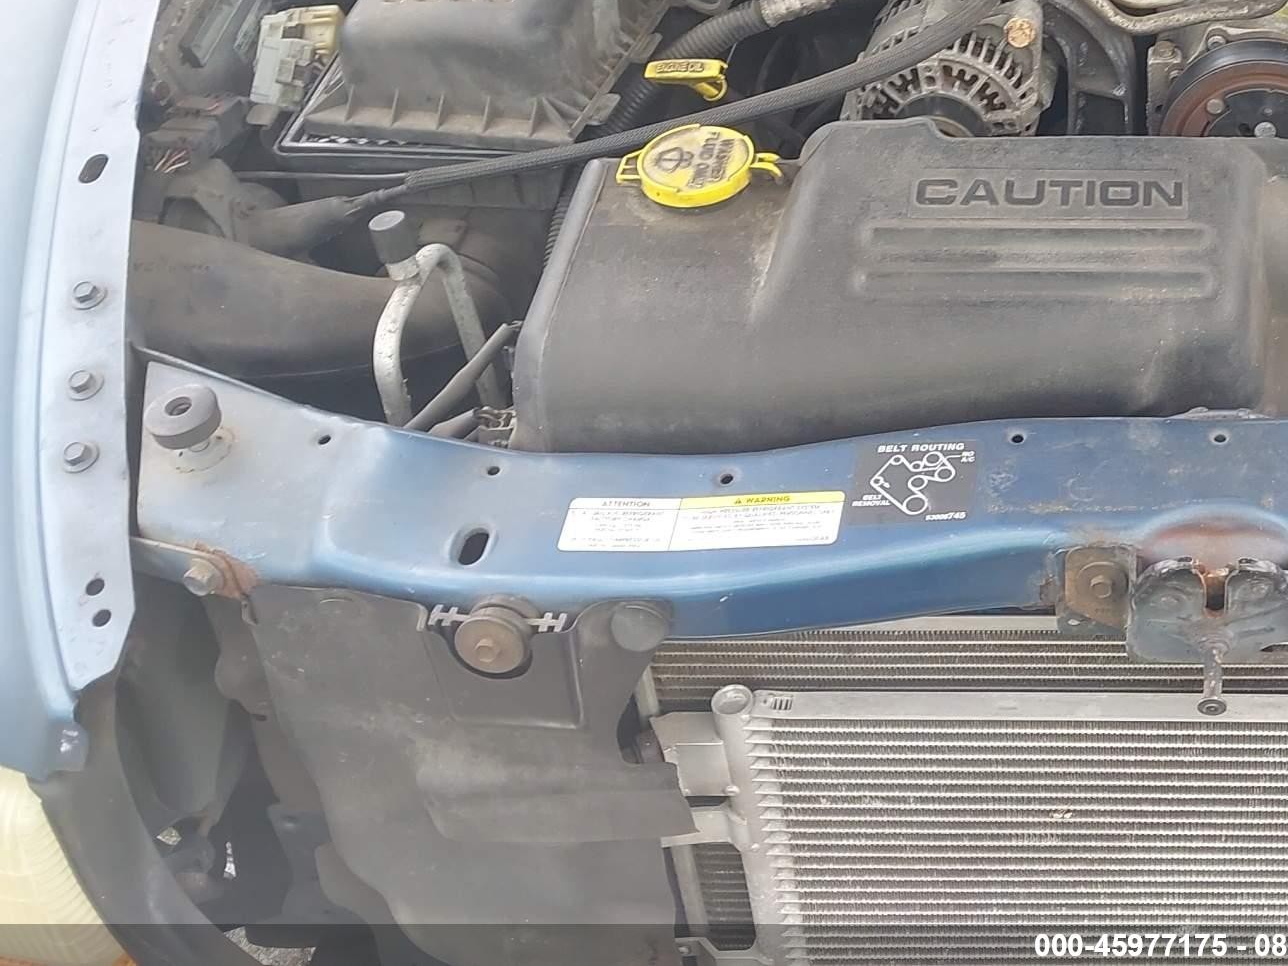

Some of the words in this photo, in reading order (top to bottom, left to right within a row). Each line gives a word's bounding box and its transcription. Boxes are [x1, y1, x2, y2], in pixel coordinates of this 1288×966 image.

[656, 61, 687, 73] ENGINE
[688, 61, 704, 73] OIL
[914, 178, 1184, 208] CAUTION
[877, 444, 908, 453] BELT
[911, 443, 965, 452] ROUTING
[601, 500, 650, 508] ATTENTION
[745, 495, 791, 504] WARNING
